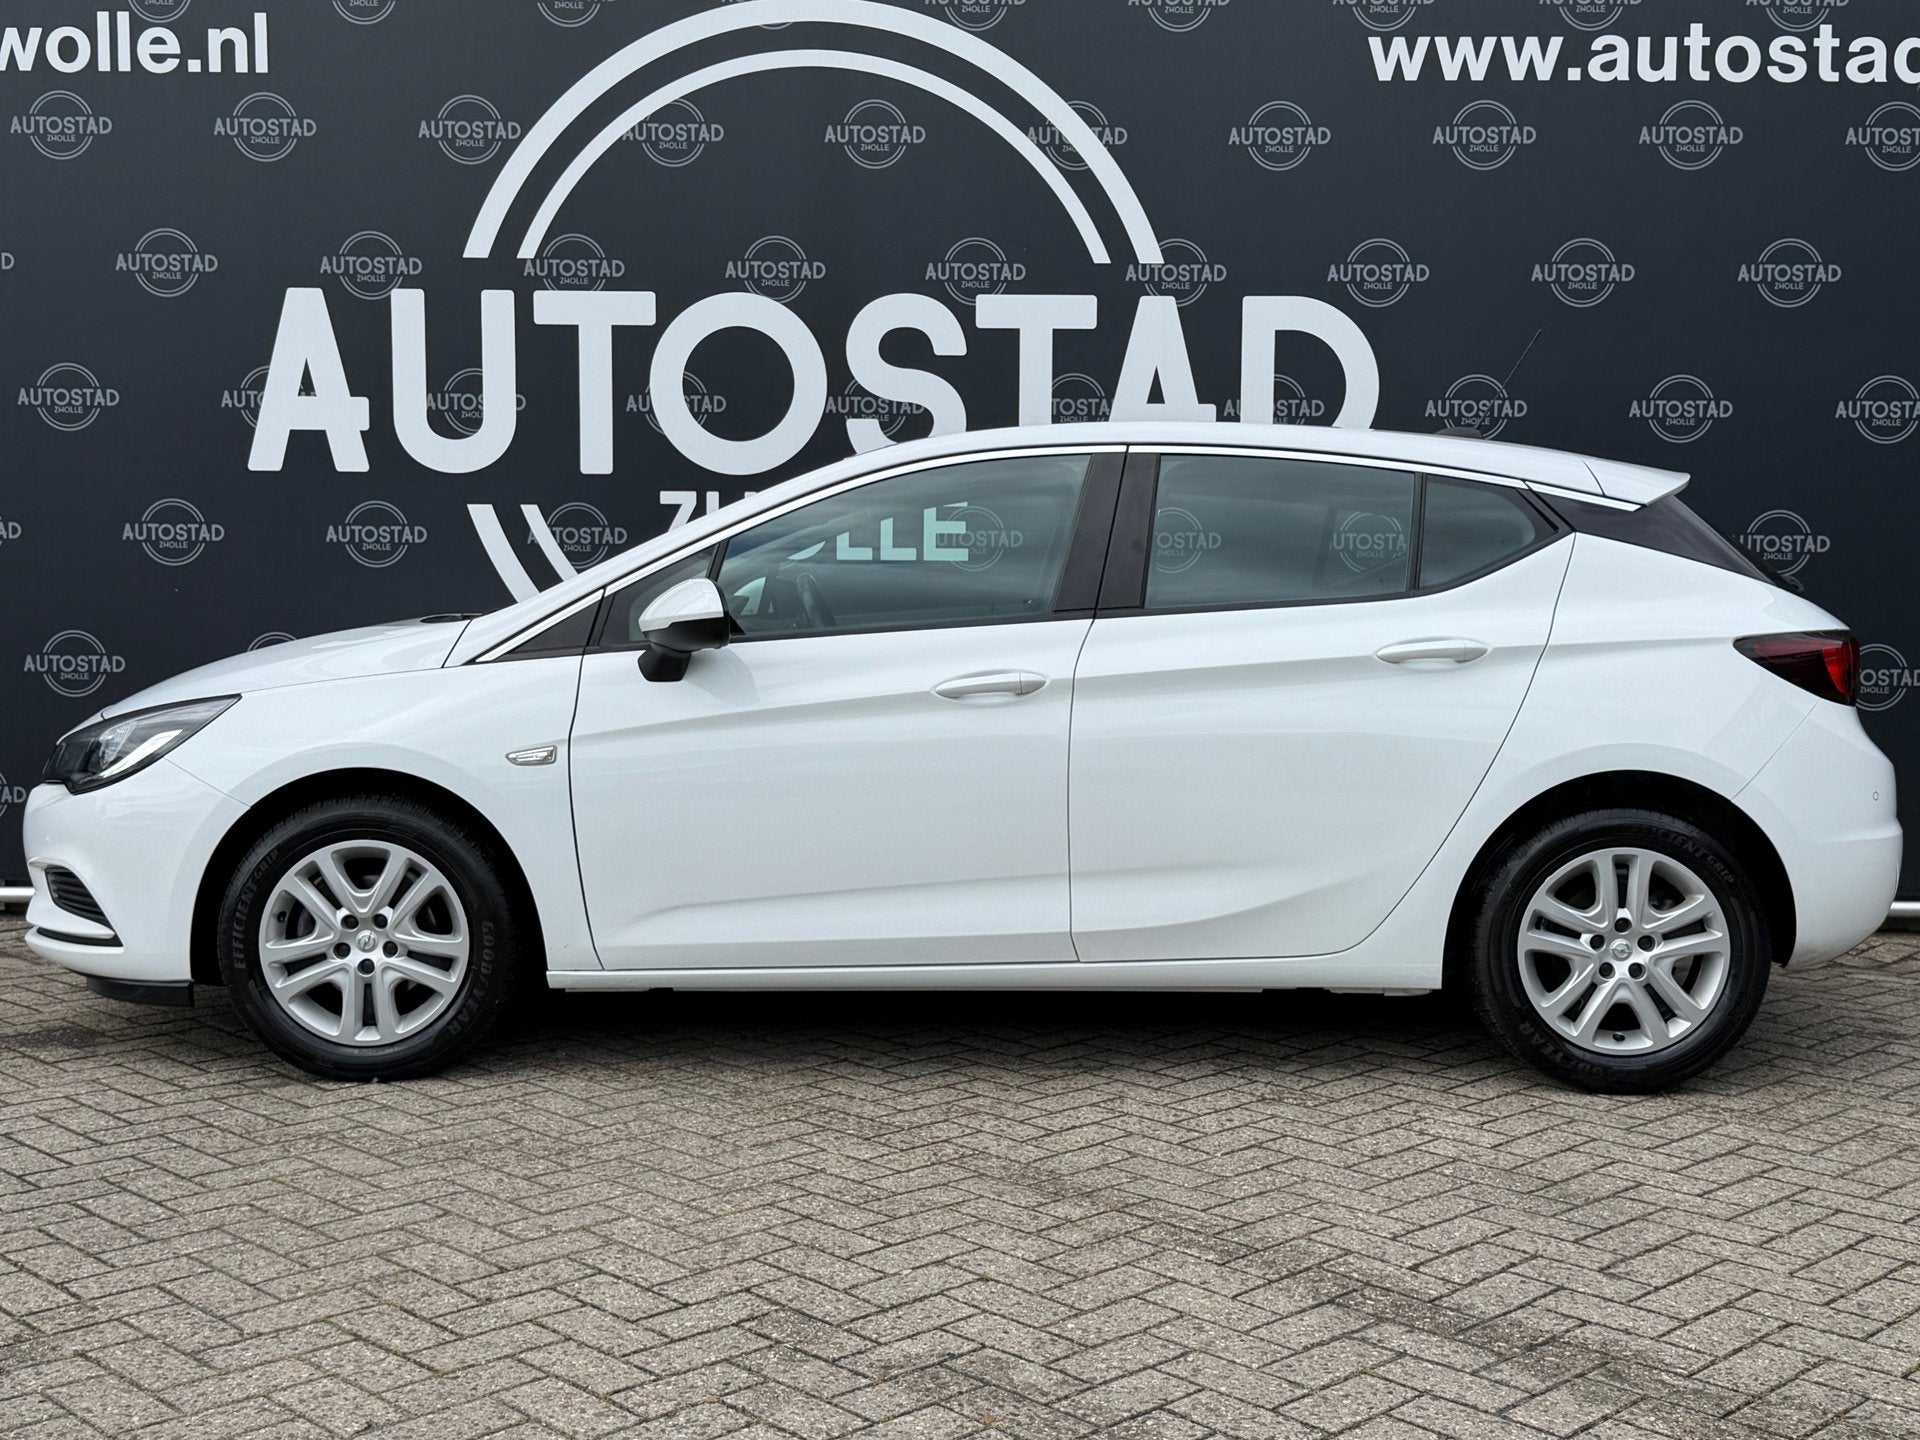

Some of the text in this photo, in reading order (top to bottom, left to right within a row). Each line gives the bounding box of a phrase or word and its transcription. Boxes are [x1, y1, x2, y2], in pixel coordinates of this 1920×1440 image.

[0, 11, 269, 74] wolle.nl
[10, 116, 112, 134] AUTOSTAD
[214, 118, 316, 137] AUTOSTAD
[418, 120, 521, 140] AUTOSTAD
[824, 125, 926, 144] AUTOSTAD
[1028, 126, 1128, 144] AUTTAD
[1228, 127, 1331, 145] AUTOSTAD
[1433, 126, 1537, 145] AUTOSTAD
[1638, 126, 1743, 145] AUTOSTAD
[115, 253, 218, 272] AUTOSTAD
[320, 256, 422, 275] AUTOSTAD
[523, 258, 625, 277] AUTOSTAD
[725, 261, 826, 279] AUTOSTAD
[925, 262, 1026, 281] AUTOSTAD
[1125, 263, 1227, 282] AUTOSTAD
[1327, 264, 1430, 283] AUTOSTAD
[1531, 264, 1635, 282] AUTOSTAD
[1737, 264, 1842, 282] AUTOSTAD
[248, 287, 1380, 475] AUTOSTAD
[18, 388, 120, 406] AUTOSTAD
[427, 393, 526, 410] AUTOD
[626, 394, 727, 412] AUTAD
[1425, 400, 1527, 417] AUTOSTAD
[1629, 400, 1733, 418] AUTOSTAD
[122, 522, 225, 542] AUTOSTAD
[326, 525, 428, 543] AUTOSTAD
[527, 527, 627, 545] ATOSTAD
[936, 530, 1023, 547] UTOSTAD
[24, 655, 126, 672] AUTOSTAD
